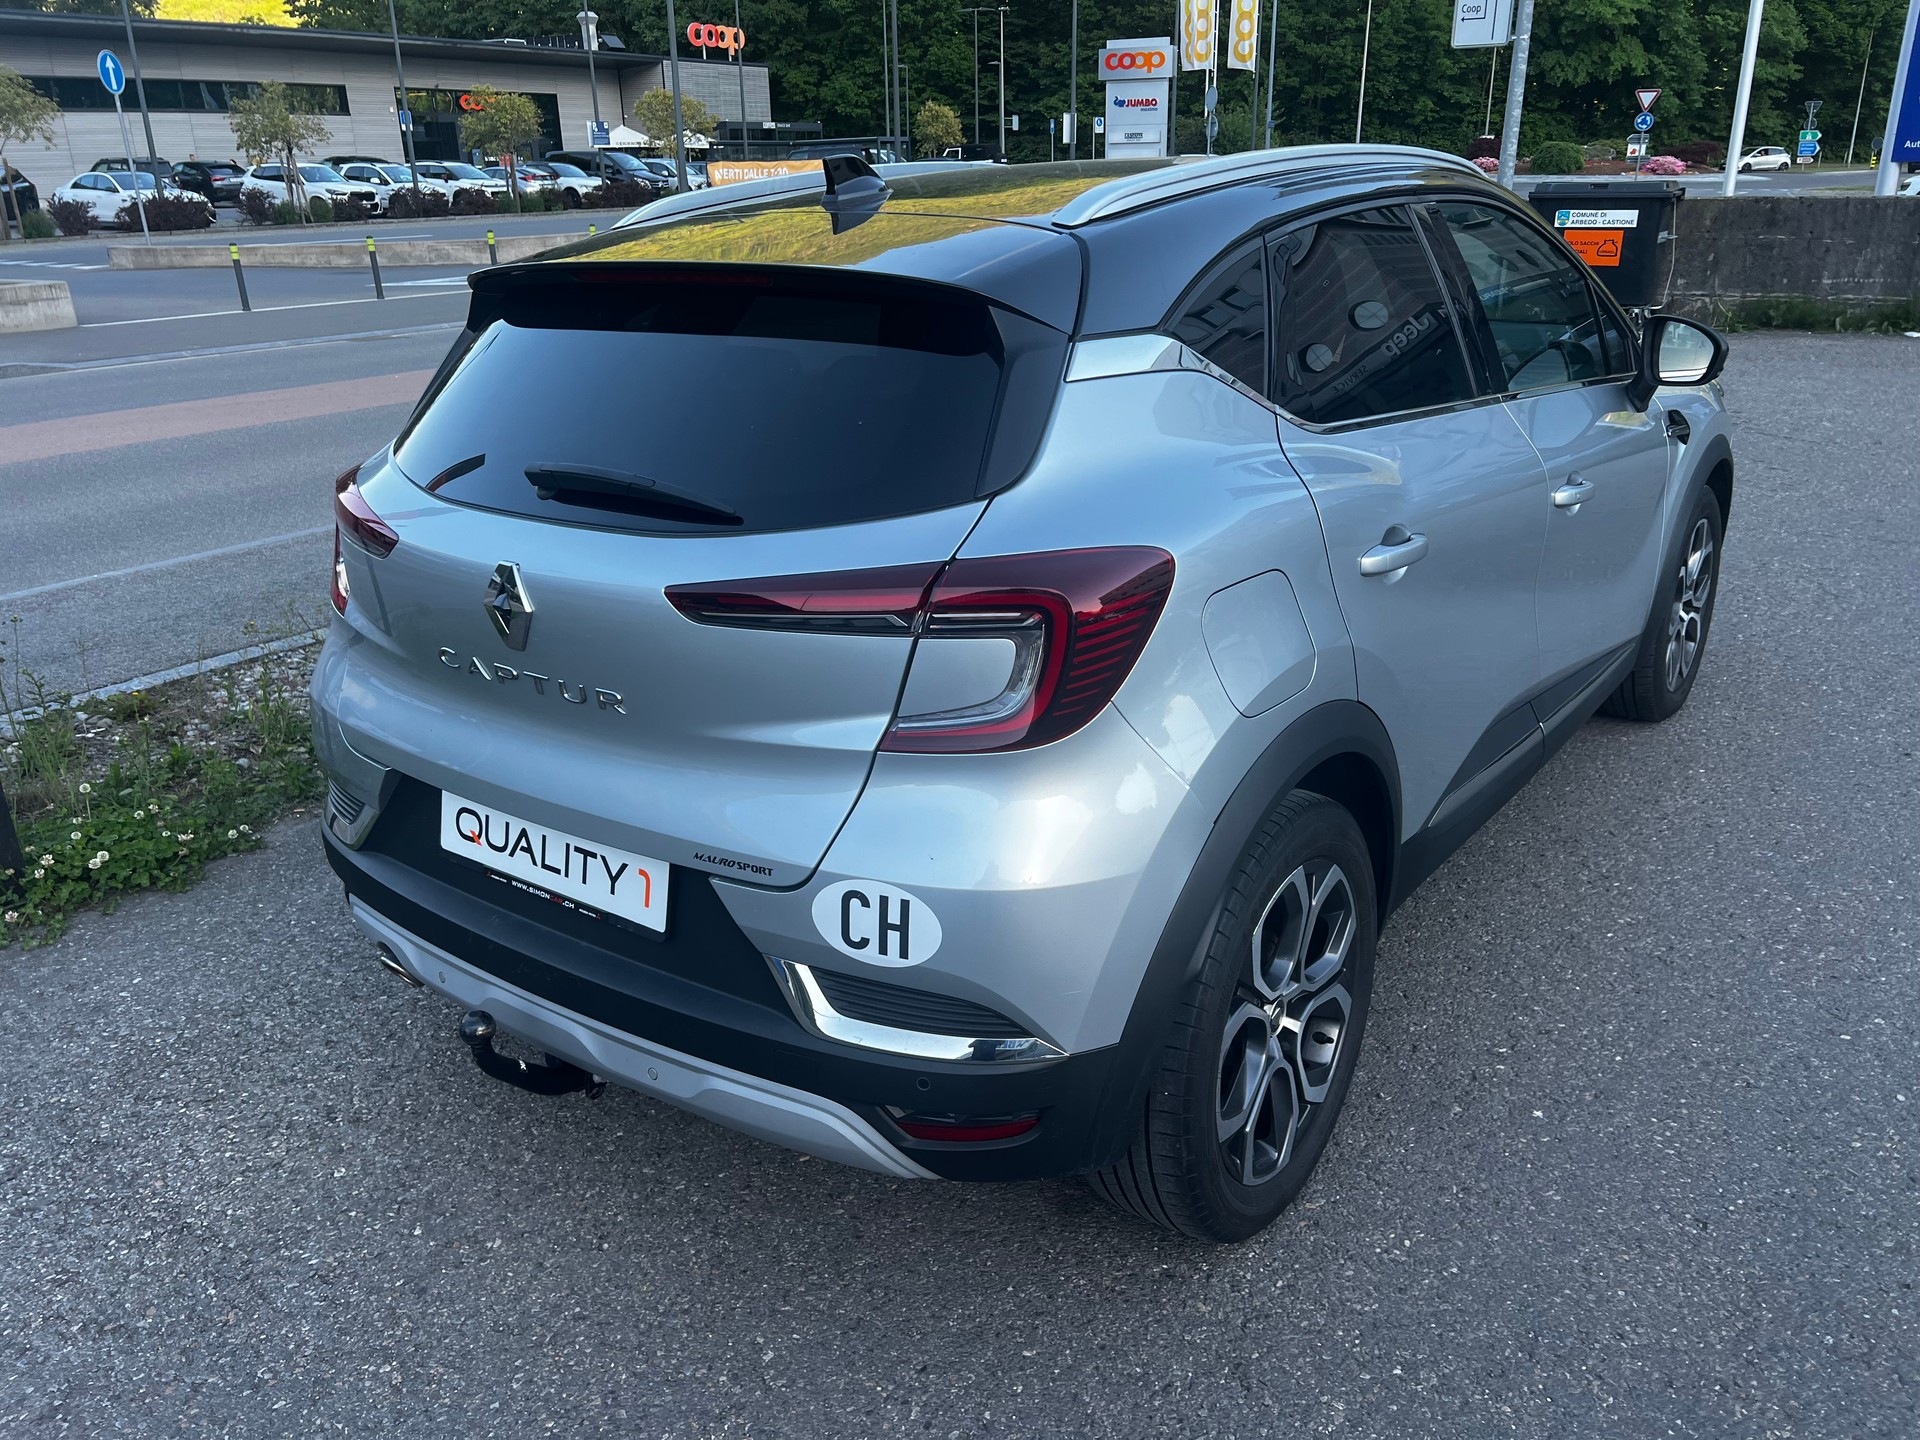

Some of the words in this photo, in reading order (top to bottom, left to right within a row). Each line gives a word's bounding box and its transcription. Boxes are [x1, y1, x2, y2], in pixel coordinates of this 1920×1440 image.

[1461, 4, 1482, 15] Coop
[687, 22, 745, 56] coop
[1104, 51, 1166, 74] coop
[1125, 98, 1158, 107] JUMBO
[744, 168, 769, 179] DALLE
[438, 646, 627, 715] CAPTUR
[840, 889, 911, 960] CH
